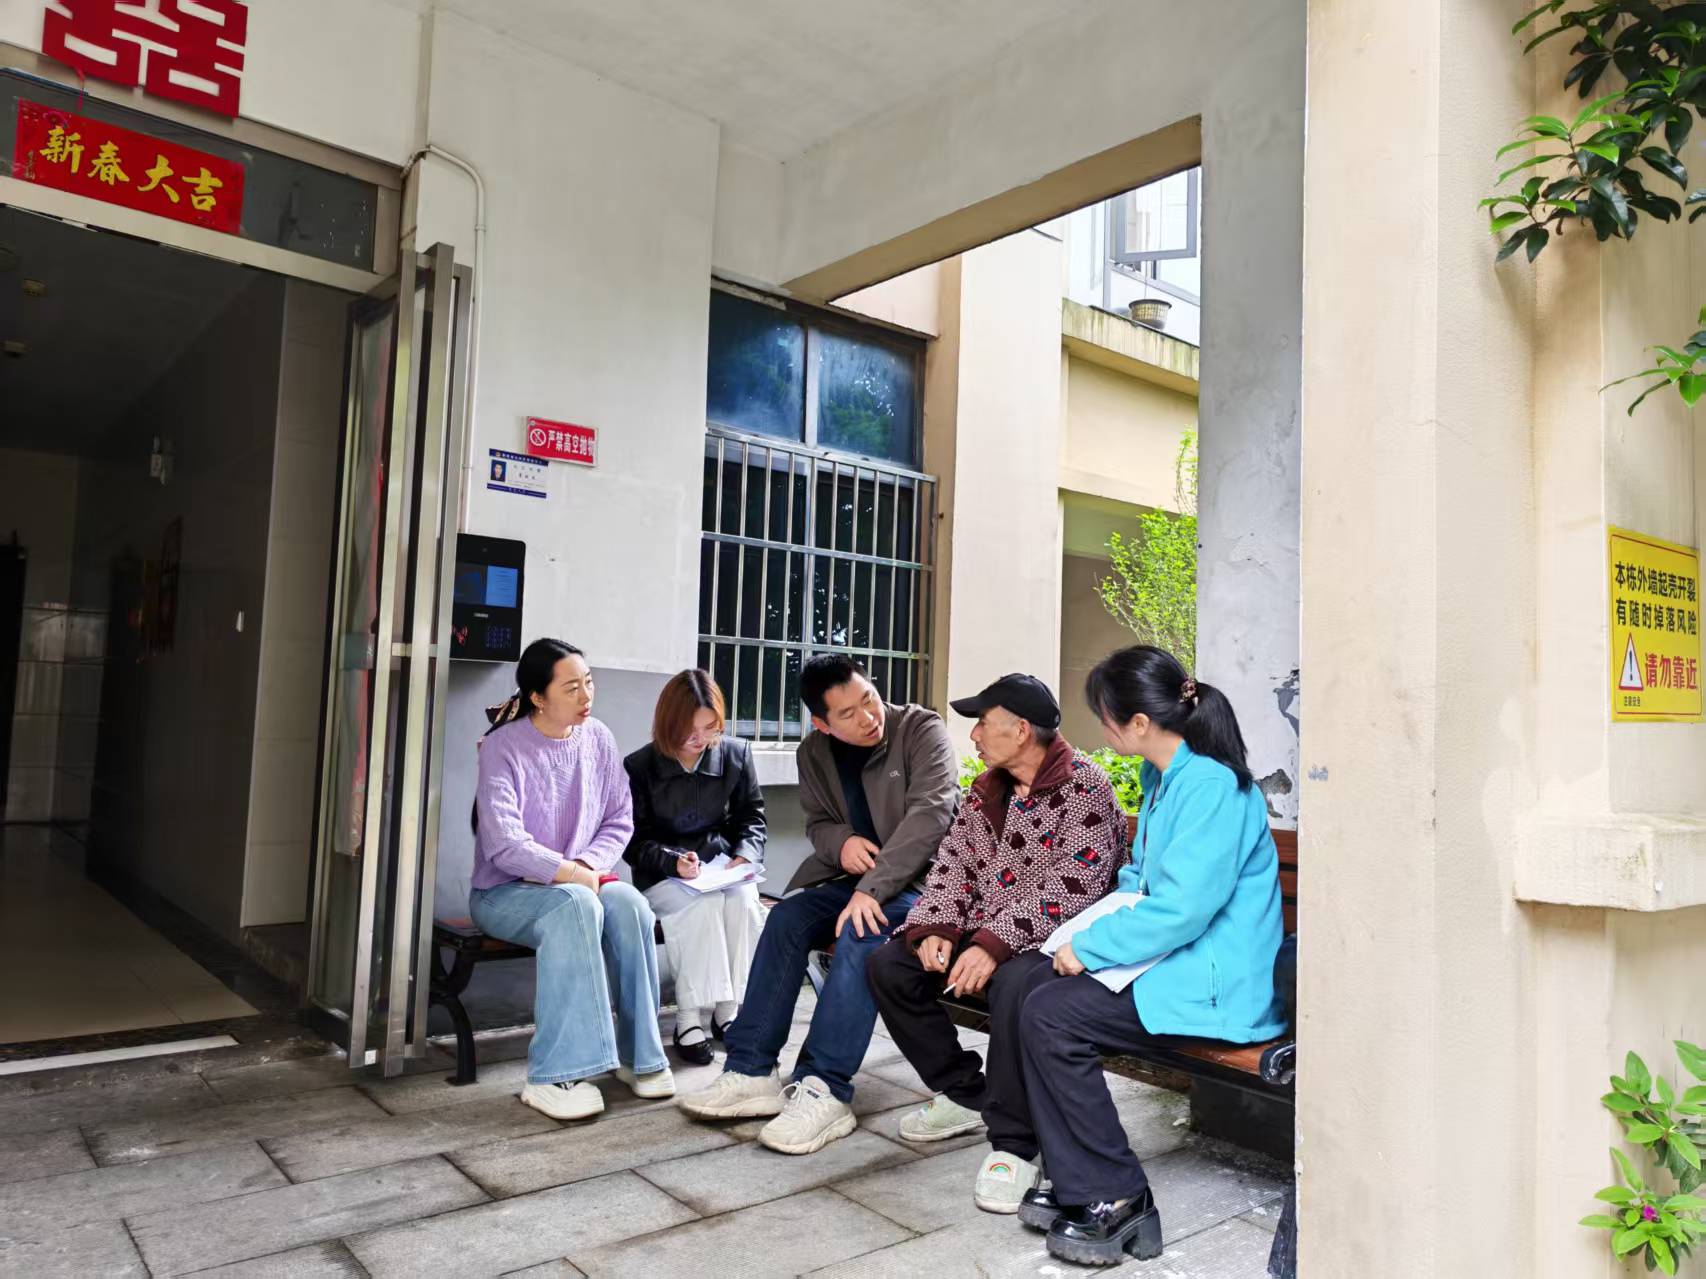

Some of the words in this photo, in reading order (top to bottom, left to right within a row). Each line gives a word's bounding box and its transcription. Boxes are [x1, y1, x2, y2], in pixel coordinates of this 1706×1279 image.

[40, 125, 223, 212] 新春大吉
[547, 429, 594, 457] 严禁高空抛物
[1615, 561, 1696, 602] 本栋外墙起壳开裂
[1616, 597, 1697, 635] 有随时掉落风险
[1645, 652, 1698, 690] 请勿靠近
